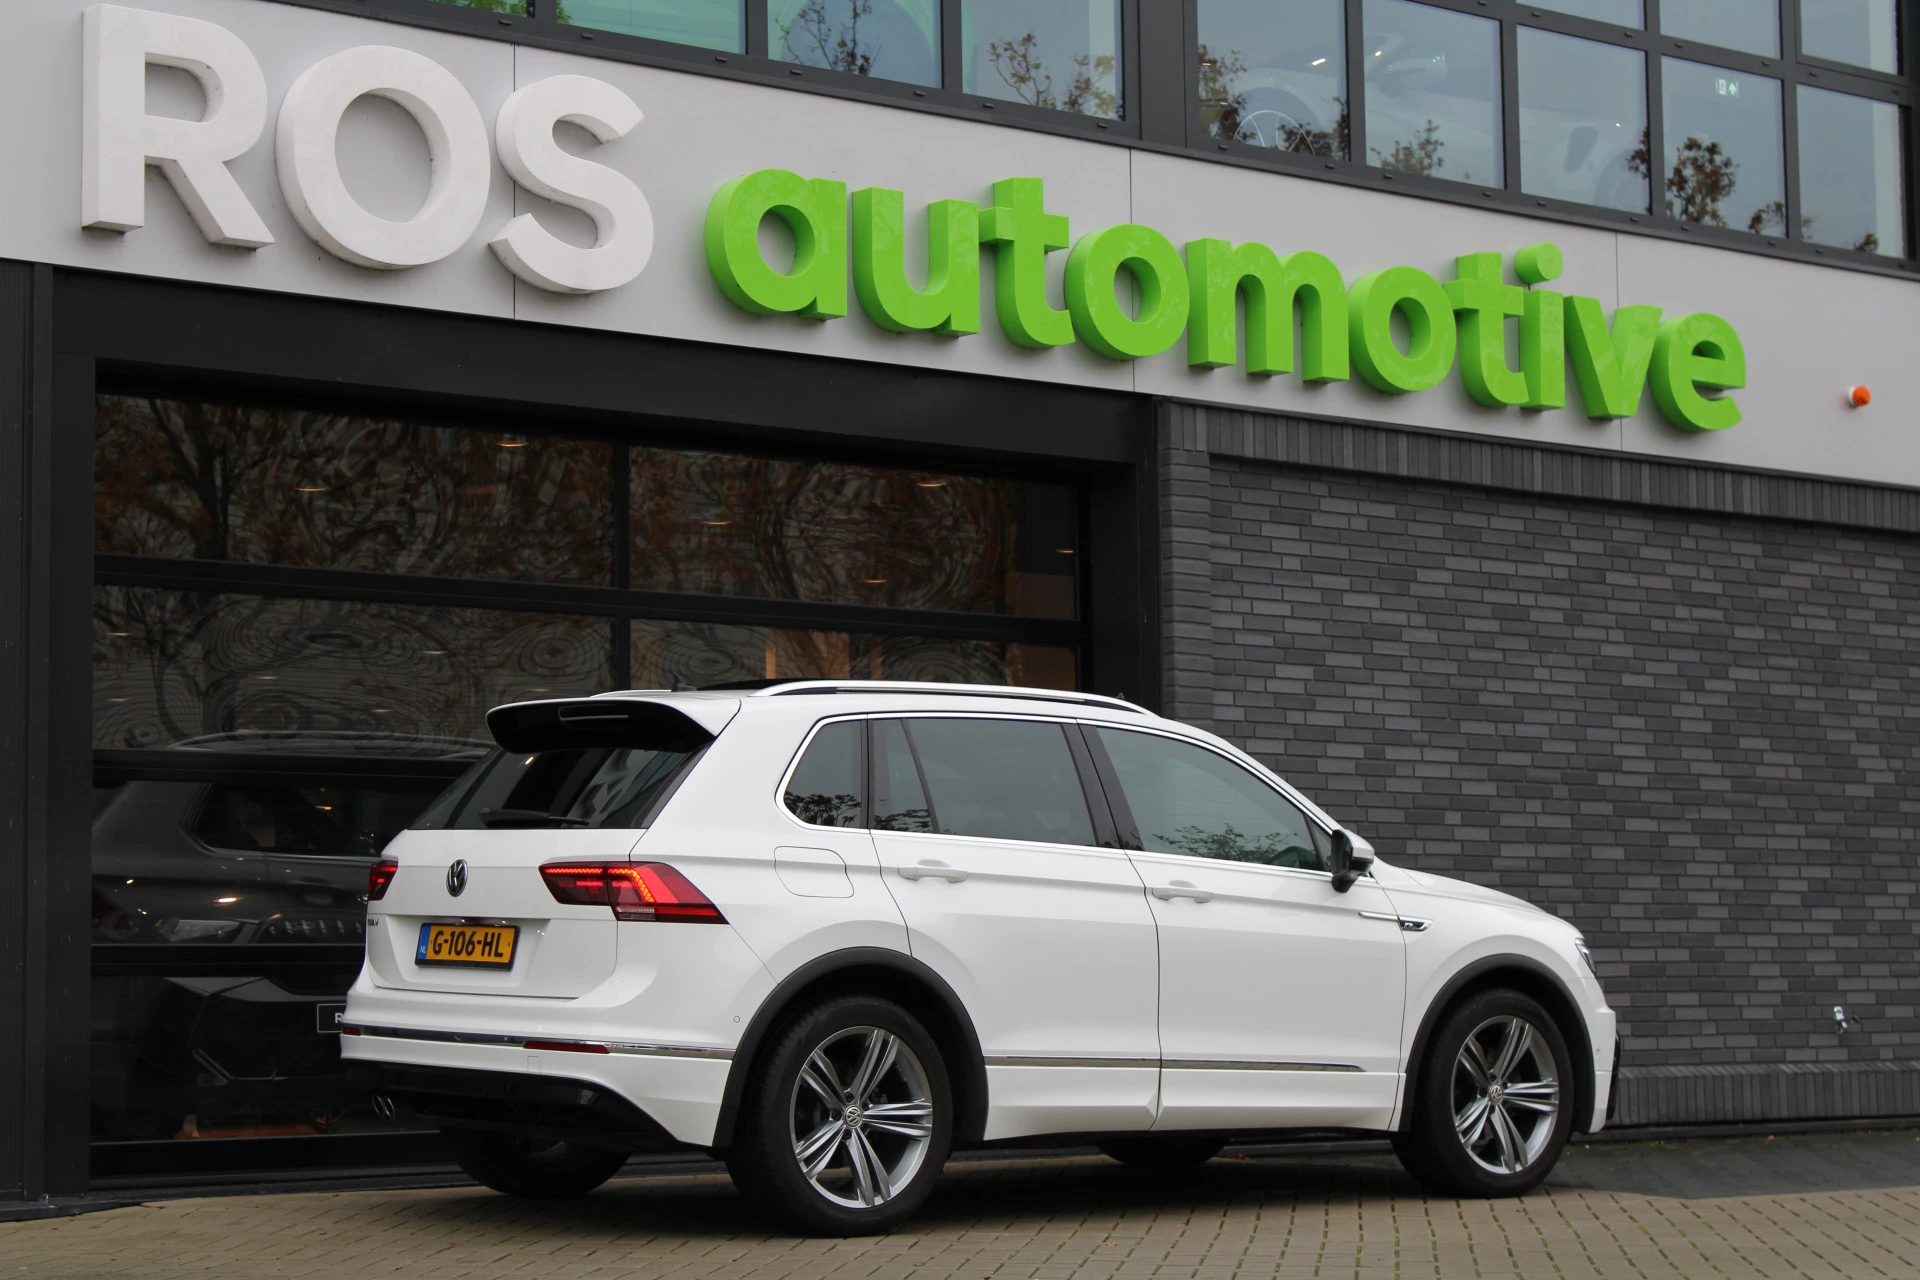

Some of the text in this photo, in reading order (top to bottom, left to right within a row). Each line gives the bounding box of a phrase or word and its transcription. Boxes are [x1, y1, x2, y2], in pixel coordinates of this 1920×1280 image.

[82, 5, 1747, 431] ROS automotive
[432, 930, 504, 958] G-106-HL
